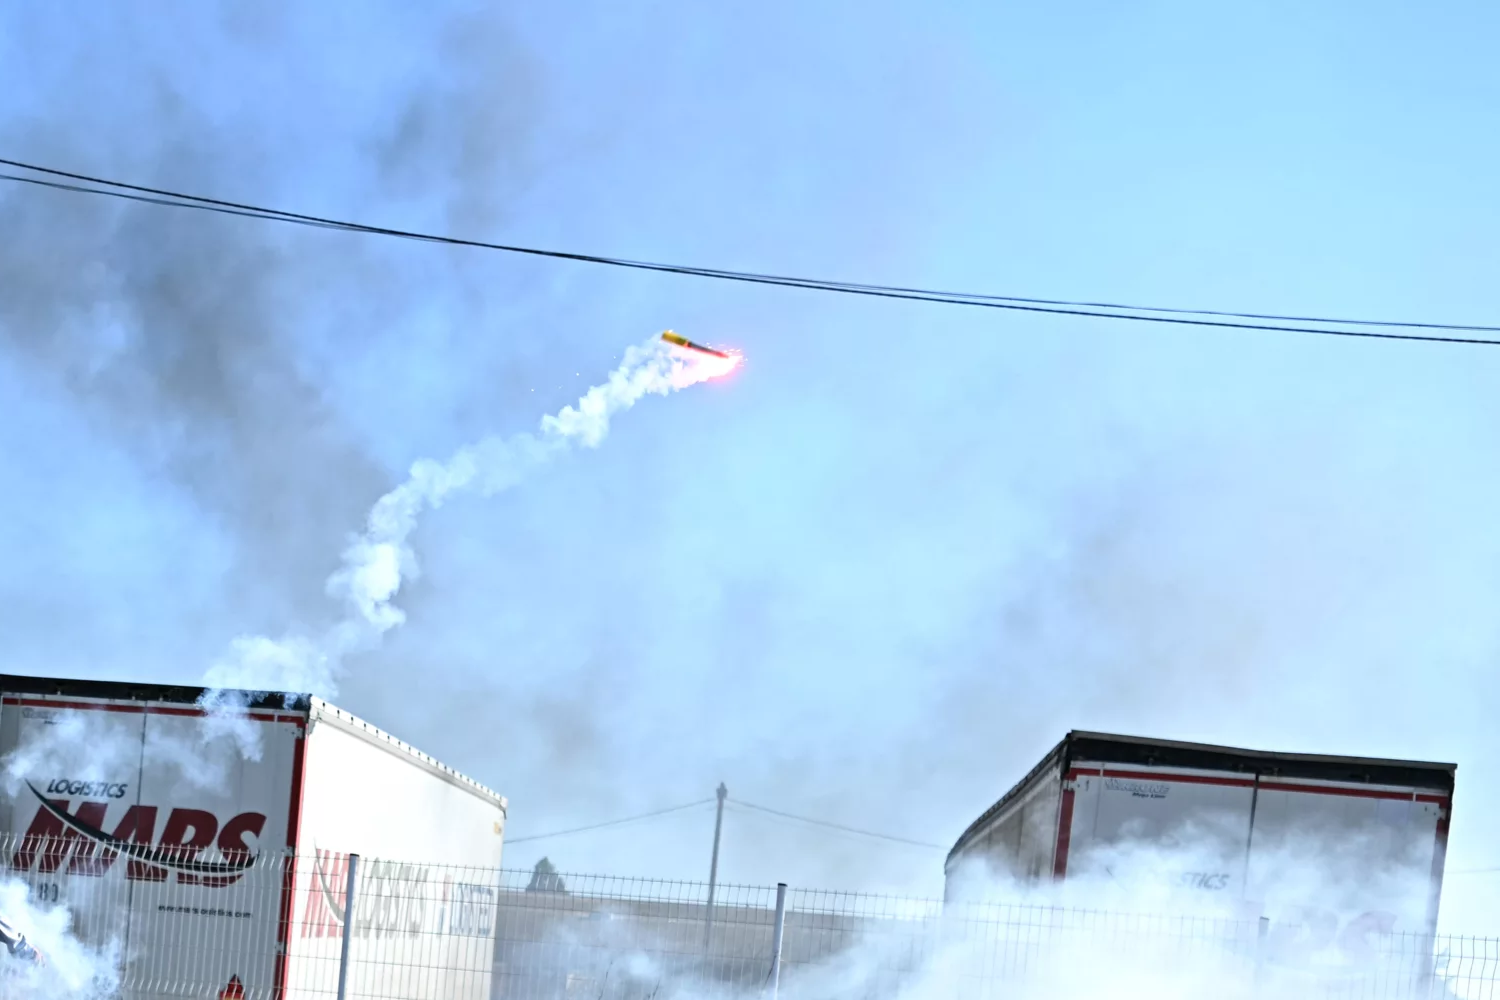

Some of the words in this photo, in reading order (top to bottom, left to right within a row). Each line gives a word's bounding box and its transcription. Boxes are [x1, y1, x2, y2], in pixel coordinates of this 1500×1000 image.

[46, 778, 129, 799] LOGISTICS
[10, 798, 268, 889] MARS
[158, 904, 253, 919] www.marsogistics.com
